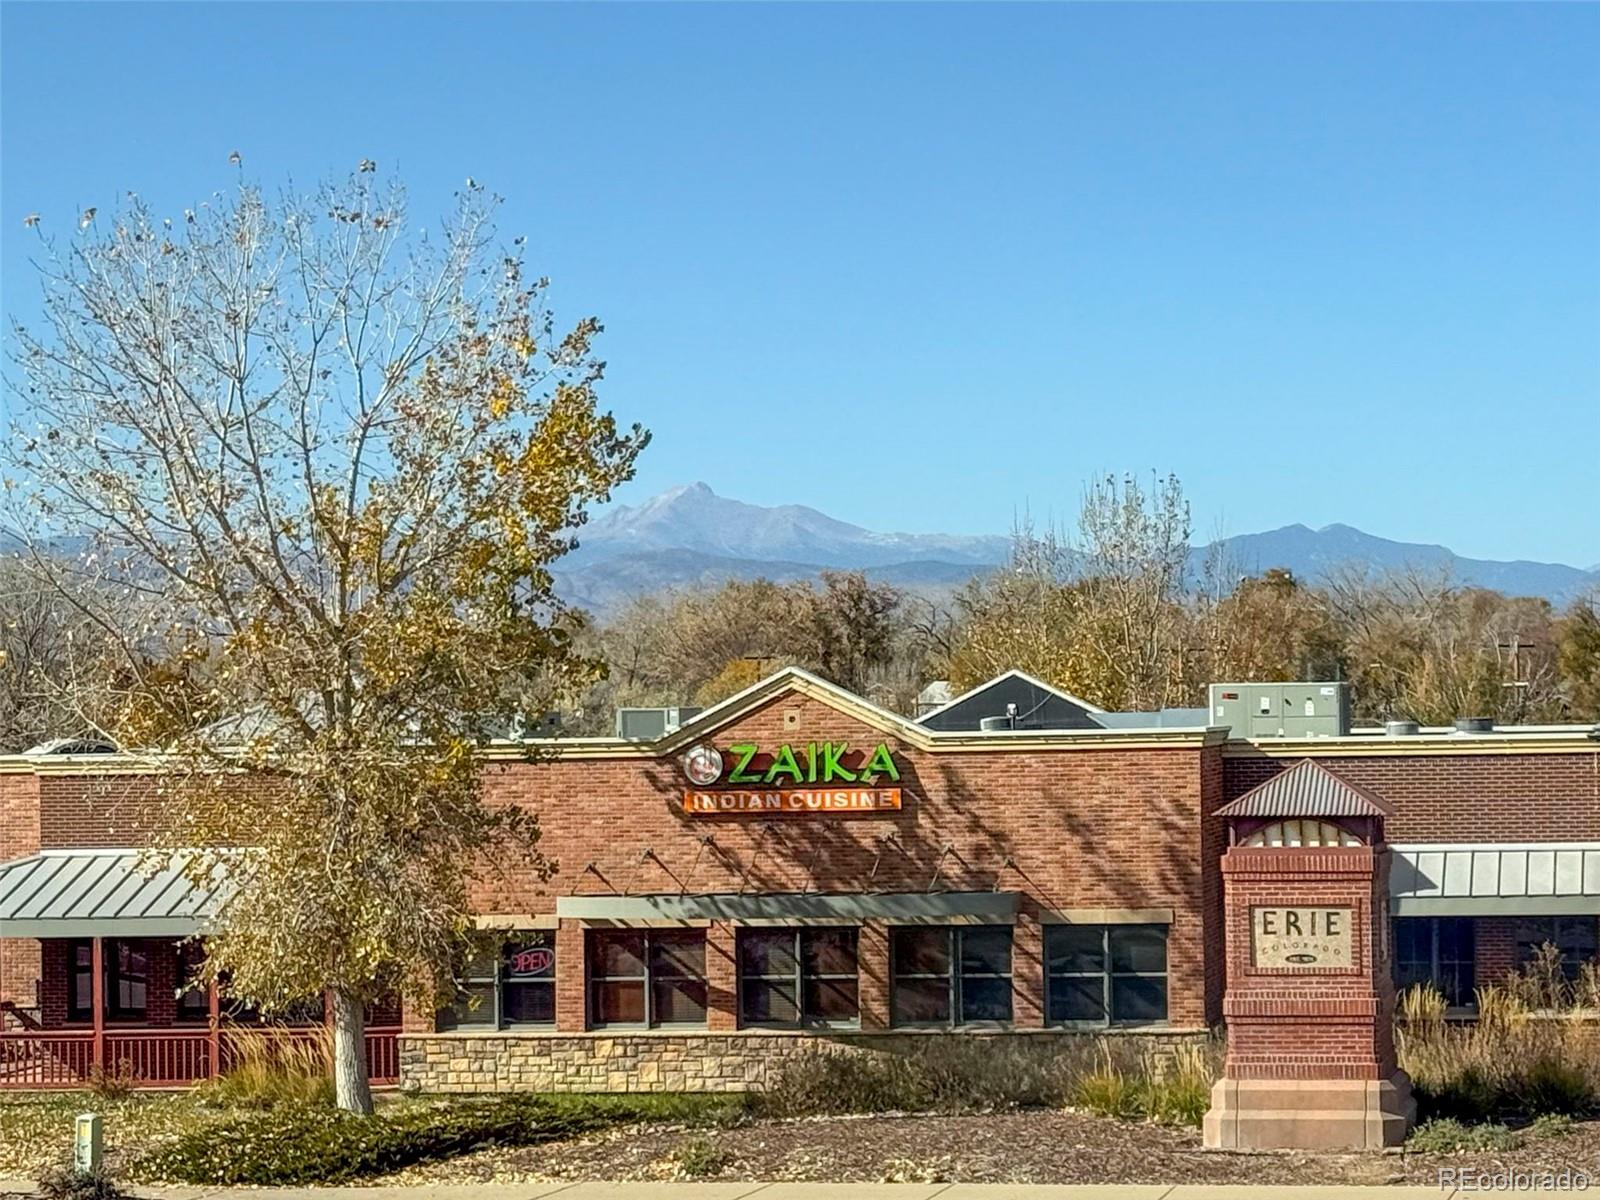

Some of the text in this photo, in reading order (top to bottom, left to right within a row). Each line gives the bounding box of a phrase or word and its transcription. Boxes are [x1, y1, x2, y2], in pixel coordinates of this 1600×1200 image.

[728, 742, 901, 783] ZAIKA
[693, 791, 894, 809] INDIAN CUISINE
[1263, 910, 1341, 936] ERIE
[511, 952, 550, 972] OPEN
